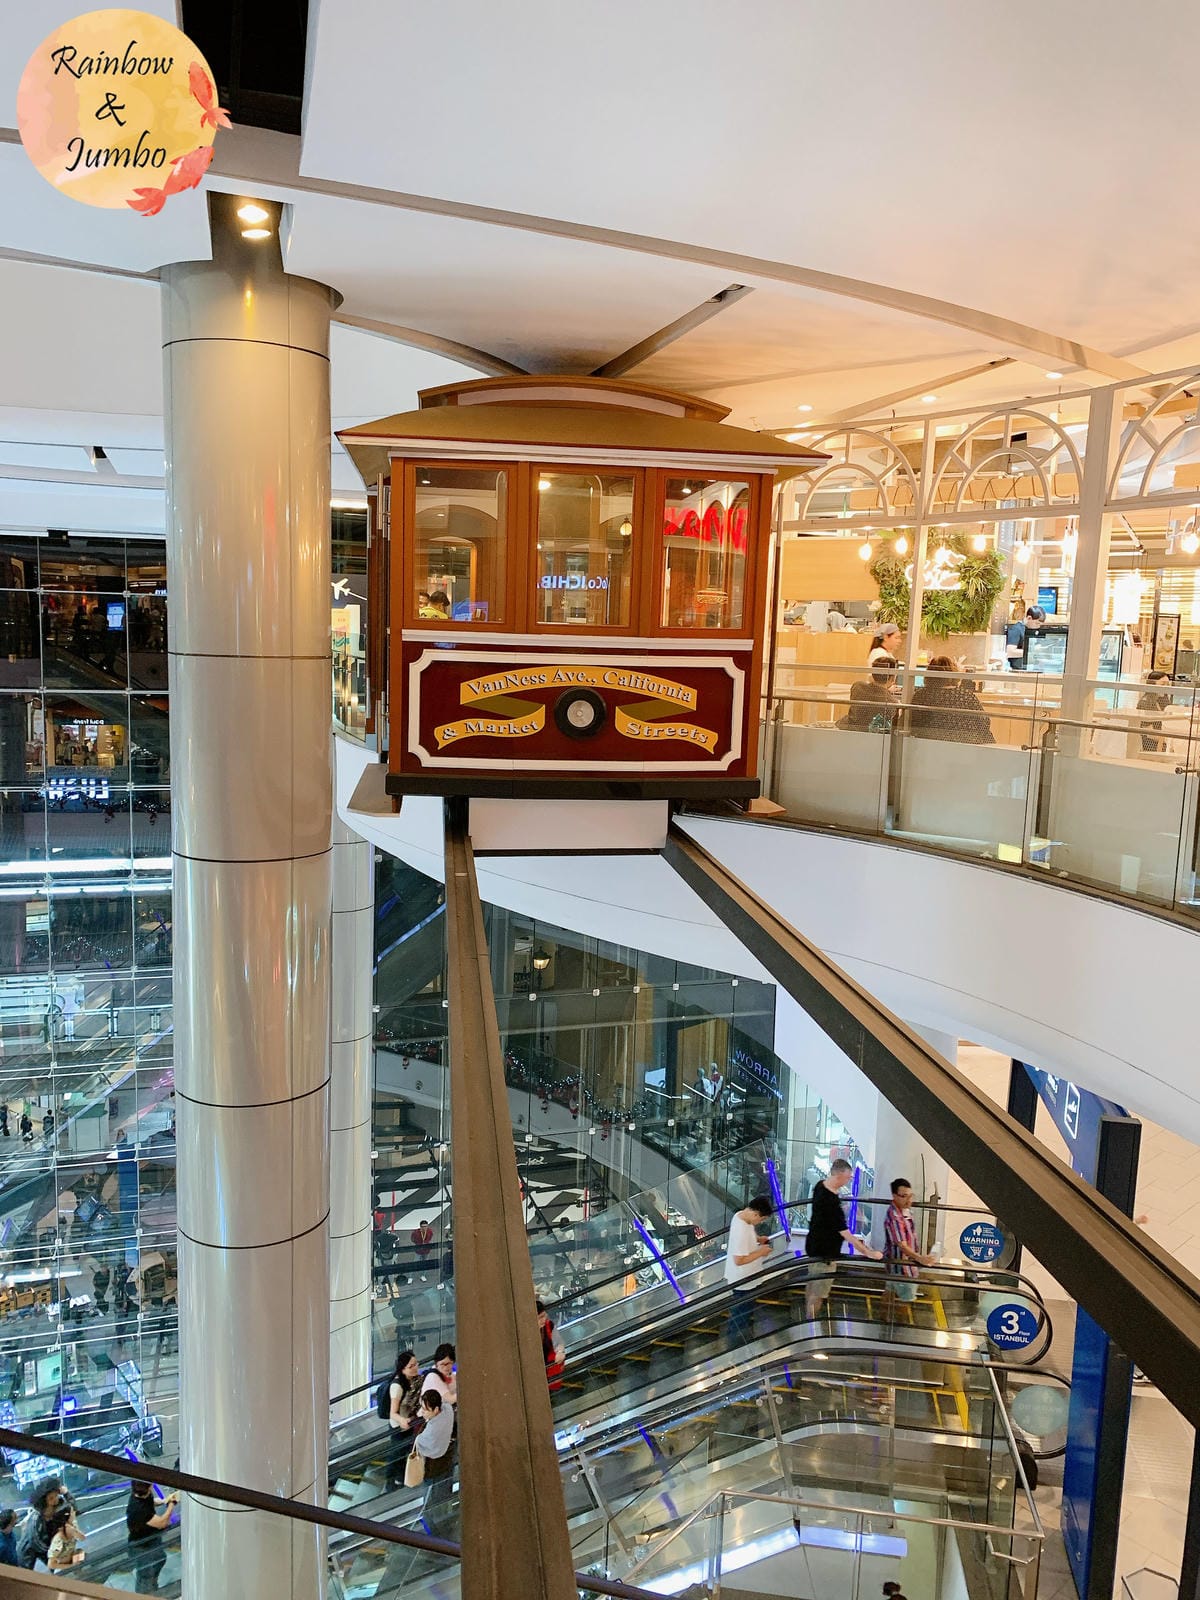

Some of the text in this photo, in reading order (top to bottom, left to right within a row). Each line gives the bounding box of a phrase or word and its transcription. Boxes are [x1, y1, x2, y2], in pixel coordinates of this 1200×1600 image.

[551, 668, 597, 686] Ave.,
[602, 670, 694, 703] California
[443, 720, 539, 741] & Market
[626, 722, 709, 743] Streets
[963, 1236, 1000, 1245] WARNING
[993, 1333, 1030, 1344] ISTANBUL
